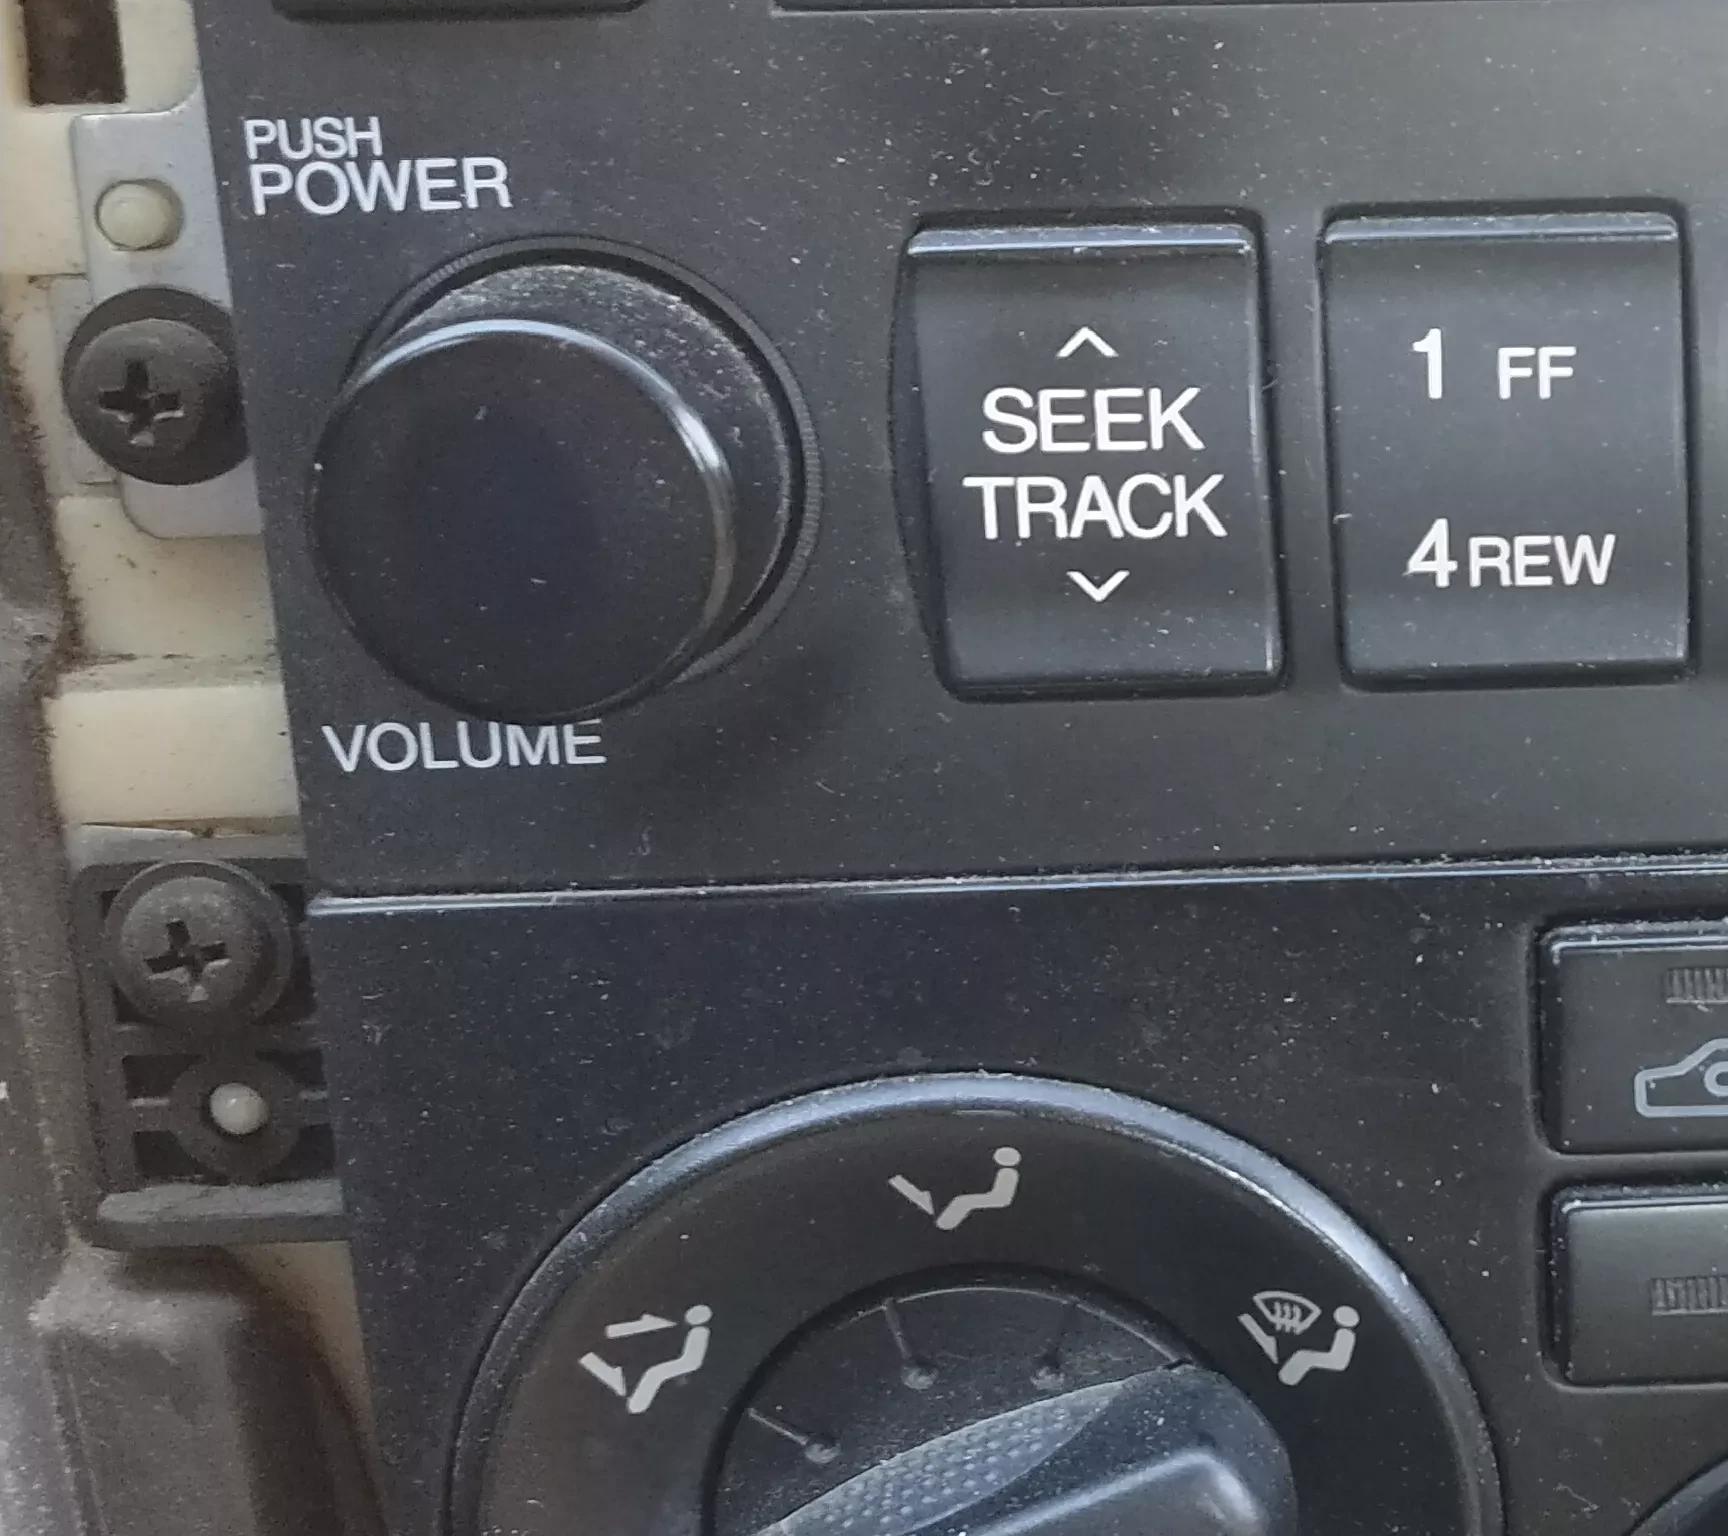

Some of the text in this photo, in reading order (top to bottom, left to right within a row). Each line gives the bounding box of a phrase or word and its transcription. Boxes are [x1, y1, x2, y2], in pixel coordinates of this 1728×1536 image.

[244, 116, 383, 160] PUSH
[250, 156, 512, 215] POWER
[1412, 327, 1577, 400] 1 FF
[982, 386, 1205, 454] SEEK
[962, 473, 1228, 540] TRACK
[1469, 534, 1616, 587] REW
[321, 720, 607, 772] VOLUME
